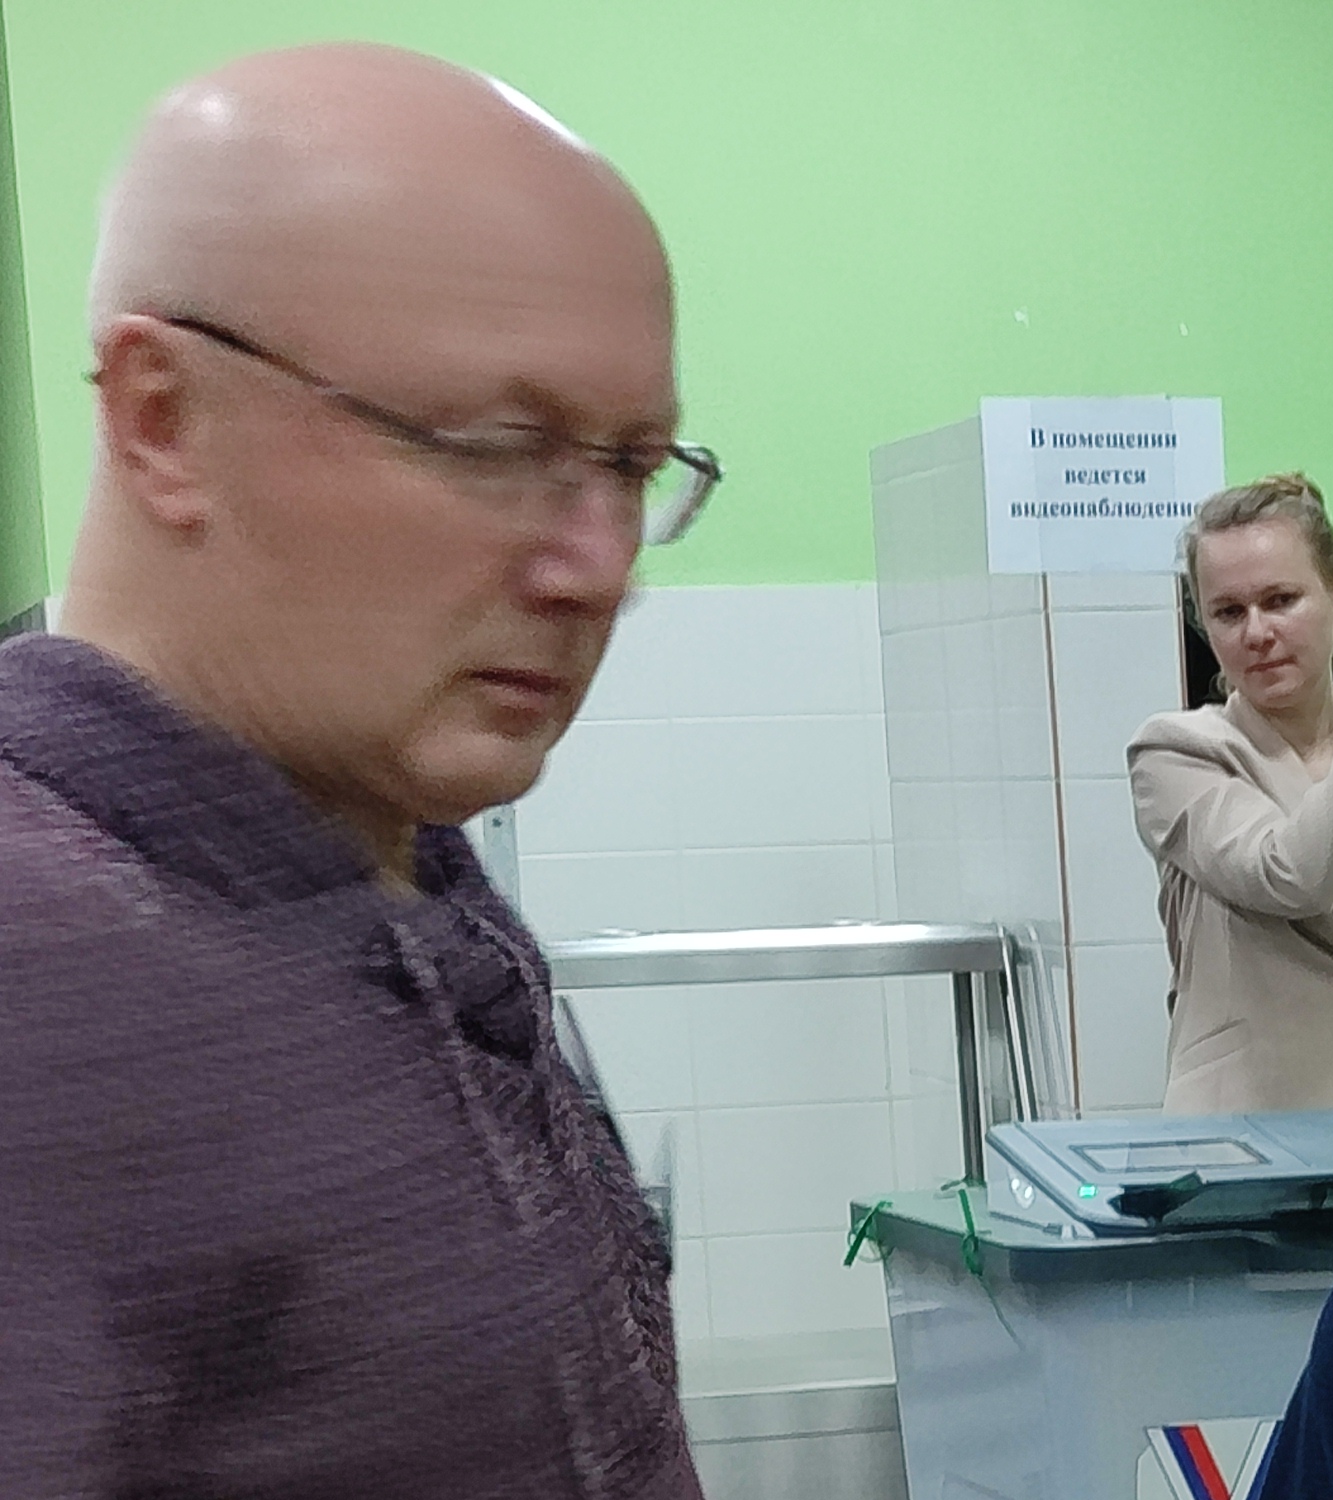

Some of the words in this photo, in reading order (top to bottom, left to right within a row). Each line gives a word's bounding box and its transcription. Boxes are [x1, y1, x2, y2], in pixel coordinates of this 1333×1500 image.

[1030, 427, 1046, 449] В
[1052, 432, 1178, 451] помещении
[1064, 468, 1147, 486] ведется
